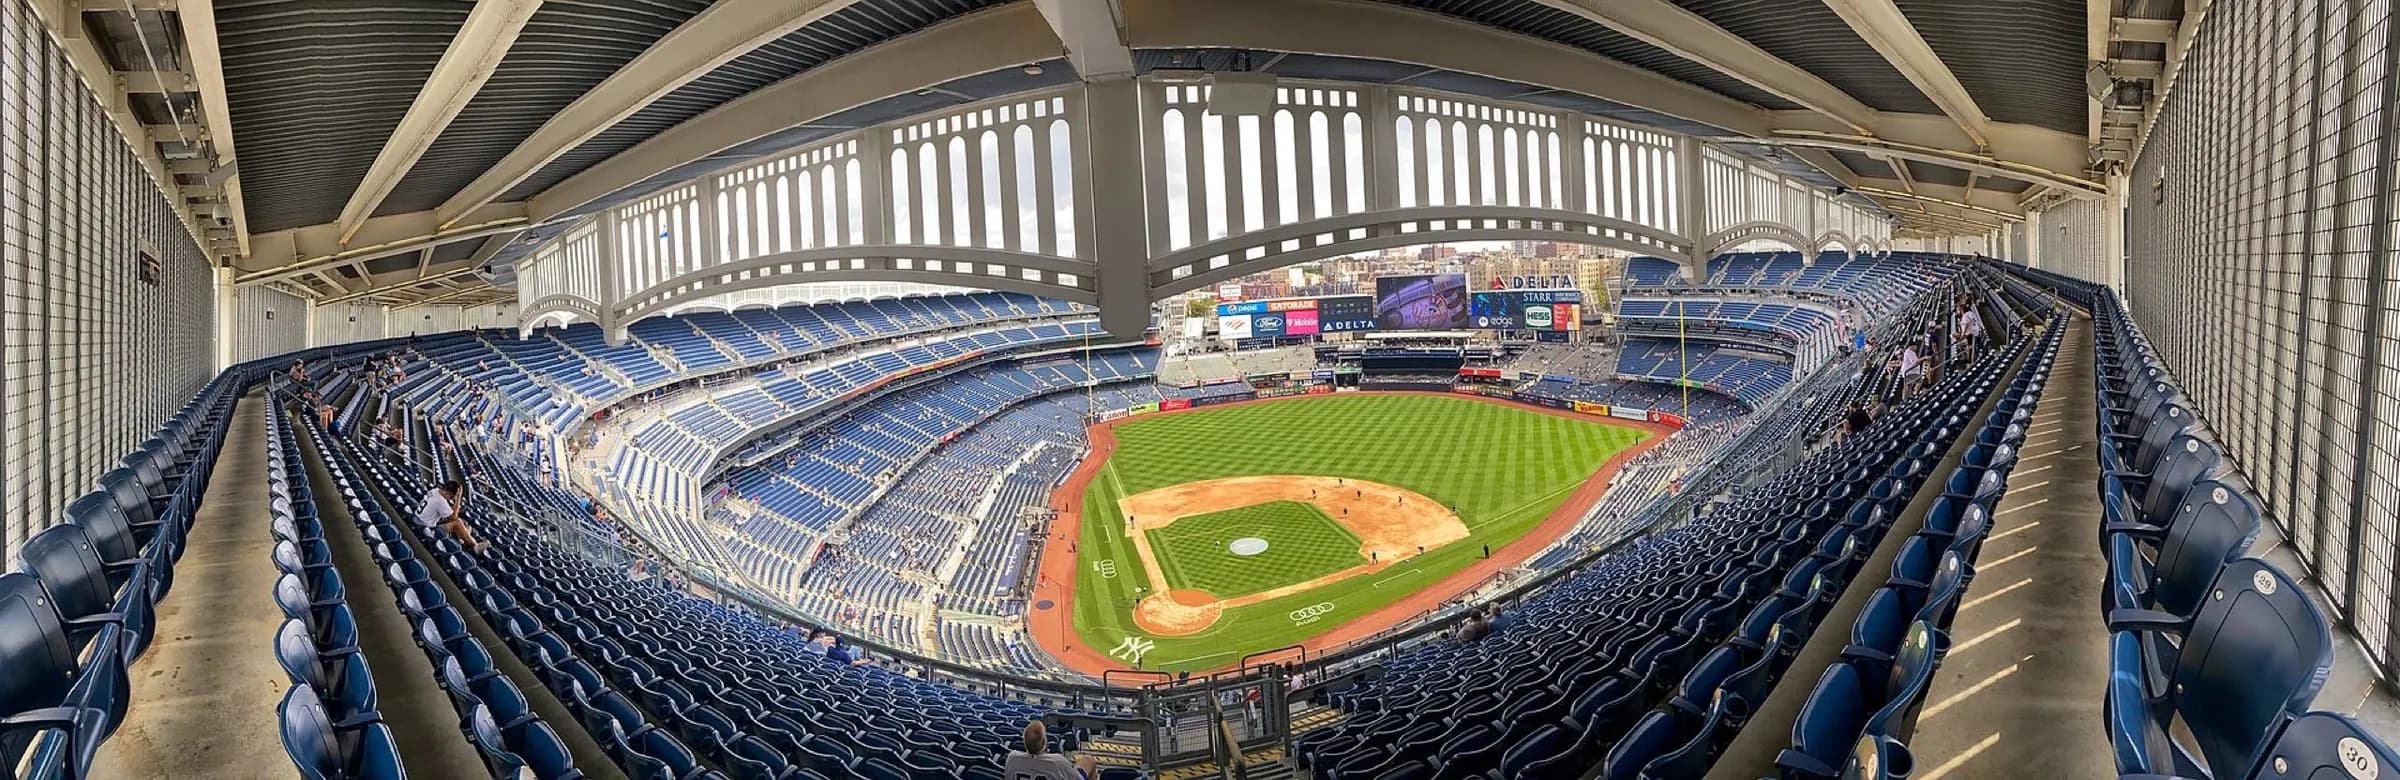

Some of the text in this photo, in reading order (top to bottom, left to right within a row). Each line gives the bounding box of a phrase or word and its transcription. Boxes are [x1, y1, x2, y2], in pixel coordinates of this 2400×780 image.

[1513, 275, 1574, 289] DELTA
[1523, 292, 1552, 302] STARR
[1238, 304, 1257, 312] pepsi
[1270, 300, 1314, 310] GATORADE
[1527, 312, 1550, 320] HESS
[1260, 318, 1278, 328] Ford
[1336, 321, 1374, 330] DELTA
[1490, 316, 1513, 328] edge
[2258, 574, 2272, 590] 29
[2346, 747, 2367, 771] 30
